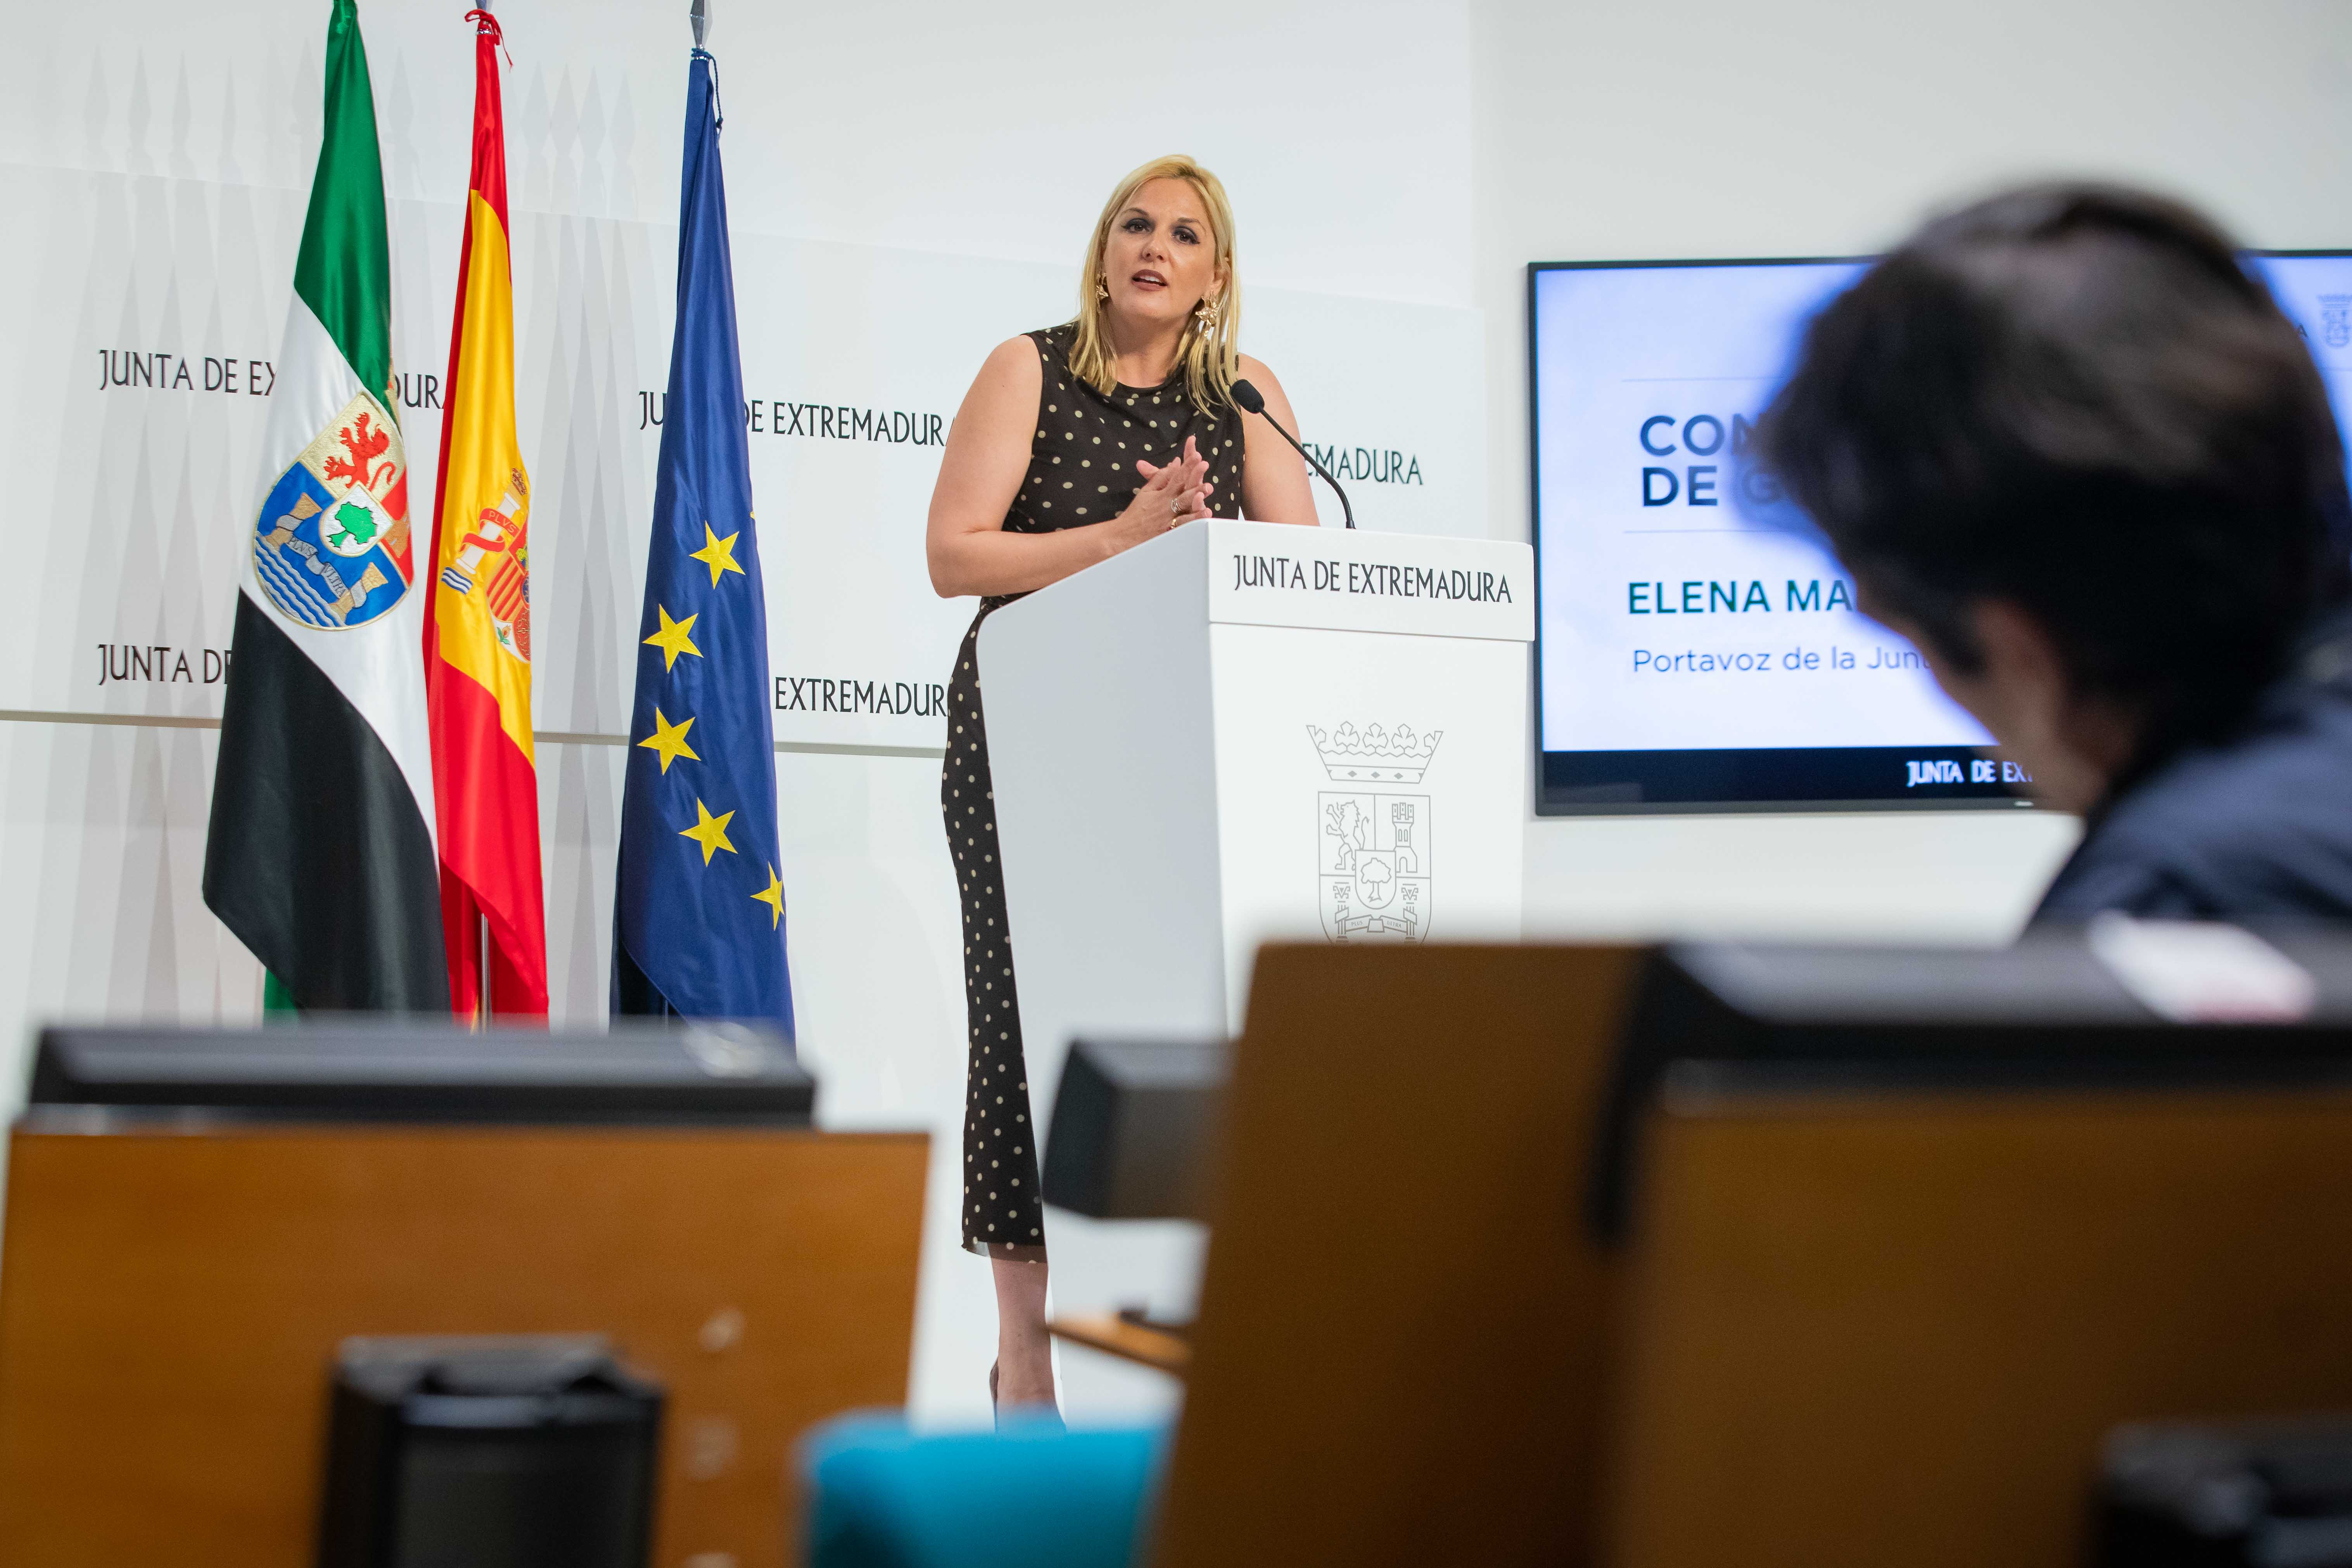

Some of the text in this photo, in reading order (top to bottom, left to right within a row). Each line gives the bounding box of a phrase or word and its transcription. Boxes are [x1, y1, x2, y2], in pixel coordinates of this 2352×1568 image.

[99, 349, 194, 390] JUNTA
[205, 357, 238, 393] DE
[774, 401, 954, 447] EXTREMADUR
[1643, 466, 1718, 507] DE
[489, 510, 516, 533] PLVS
[1234, 555, 1512, 603] JUNTA DE EXTREMADURA
[1629, 580, 1771, 614] ELENA
[98, 644, 194, 685] JUNTA
[1634, 646, 1931, 672] Portavoz de la Jun
[775, 677, 950, 717] EXTREMADUR
[1906, 760, 1965, 787] JUNTA
[1970, 760, 1997, 783] DE
